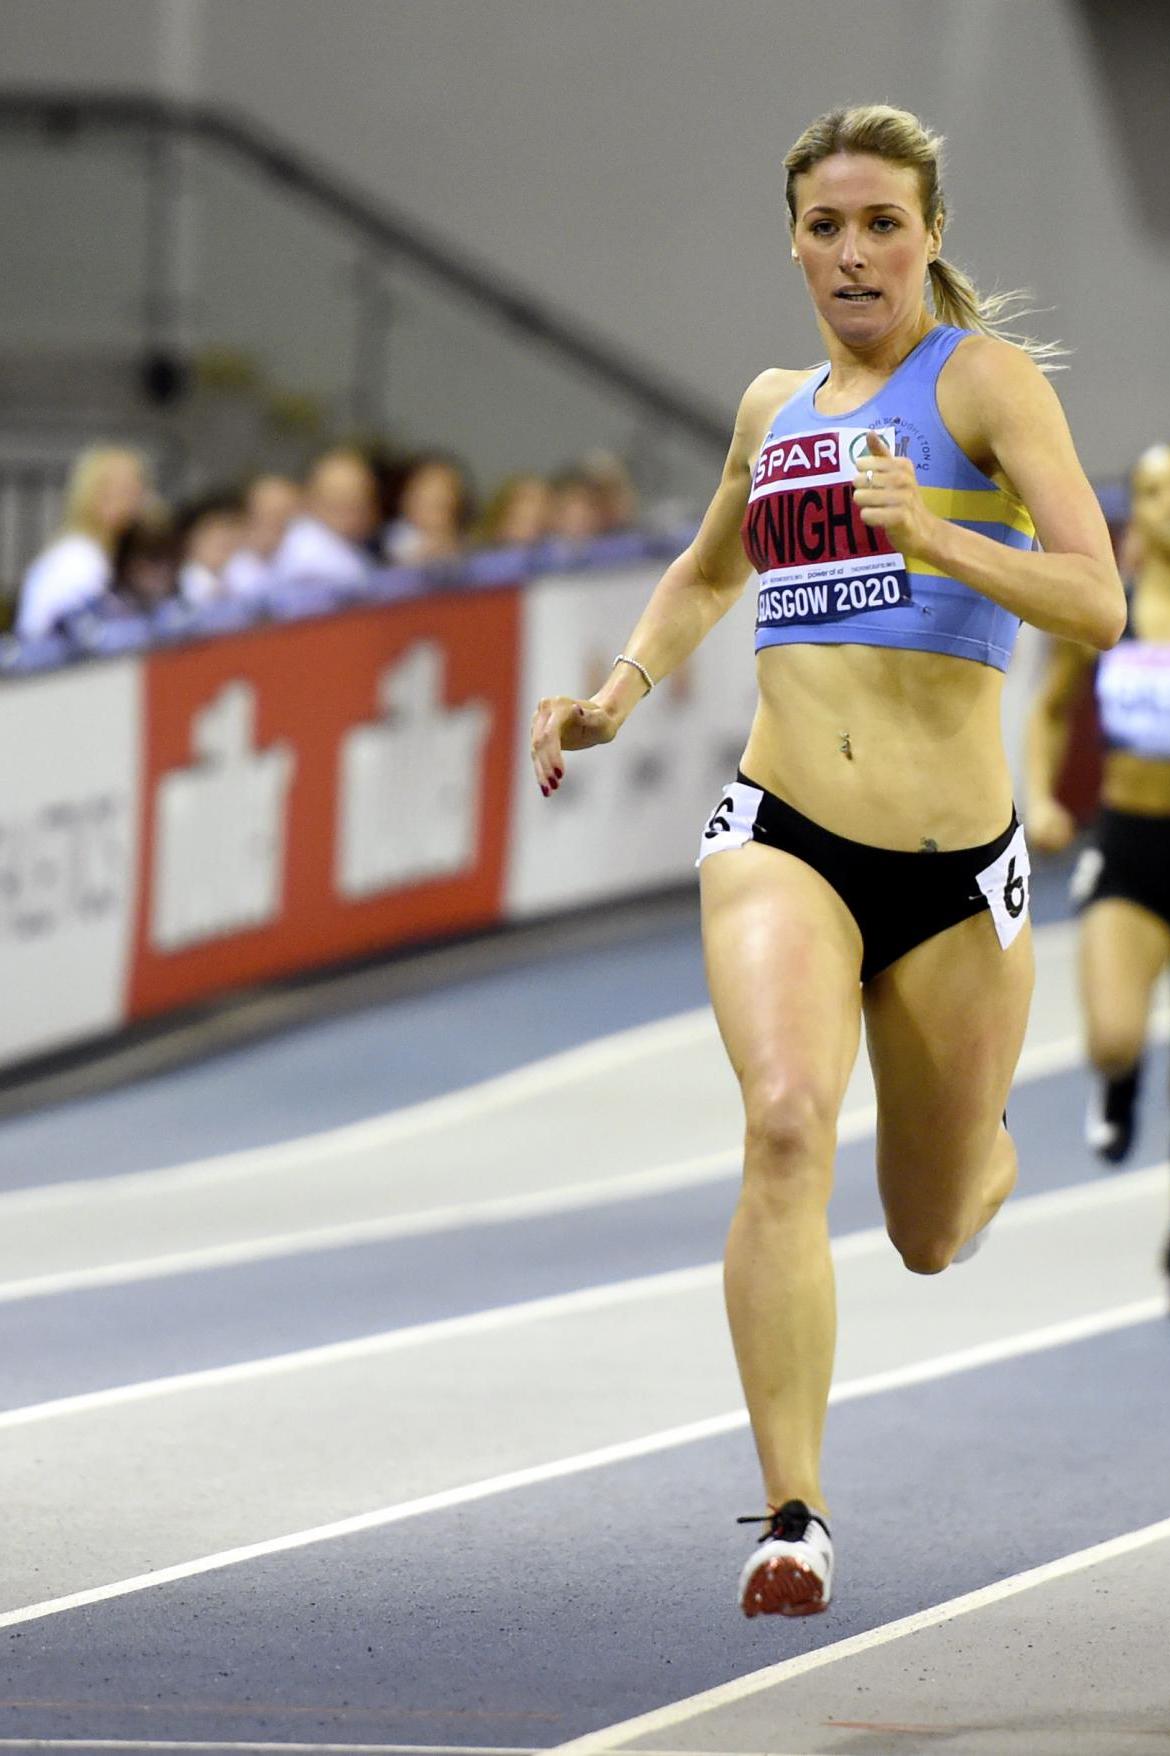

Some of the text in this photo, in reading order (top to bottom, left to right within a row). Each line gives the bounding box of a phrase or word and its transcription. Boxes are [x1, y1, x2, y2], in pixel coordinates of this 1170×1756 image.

[755, 439, 838, 483] SPAR
[807, 570, 829, 579] power
[834, 575, 901, 611] 2020
[1003, 855, 1025, 918] 6
